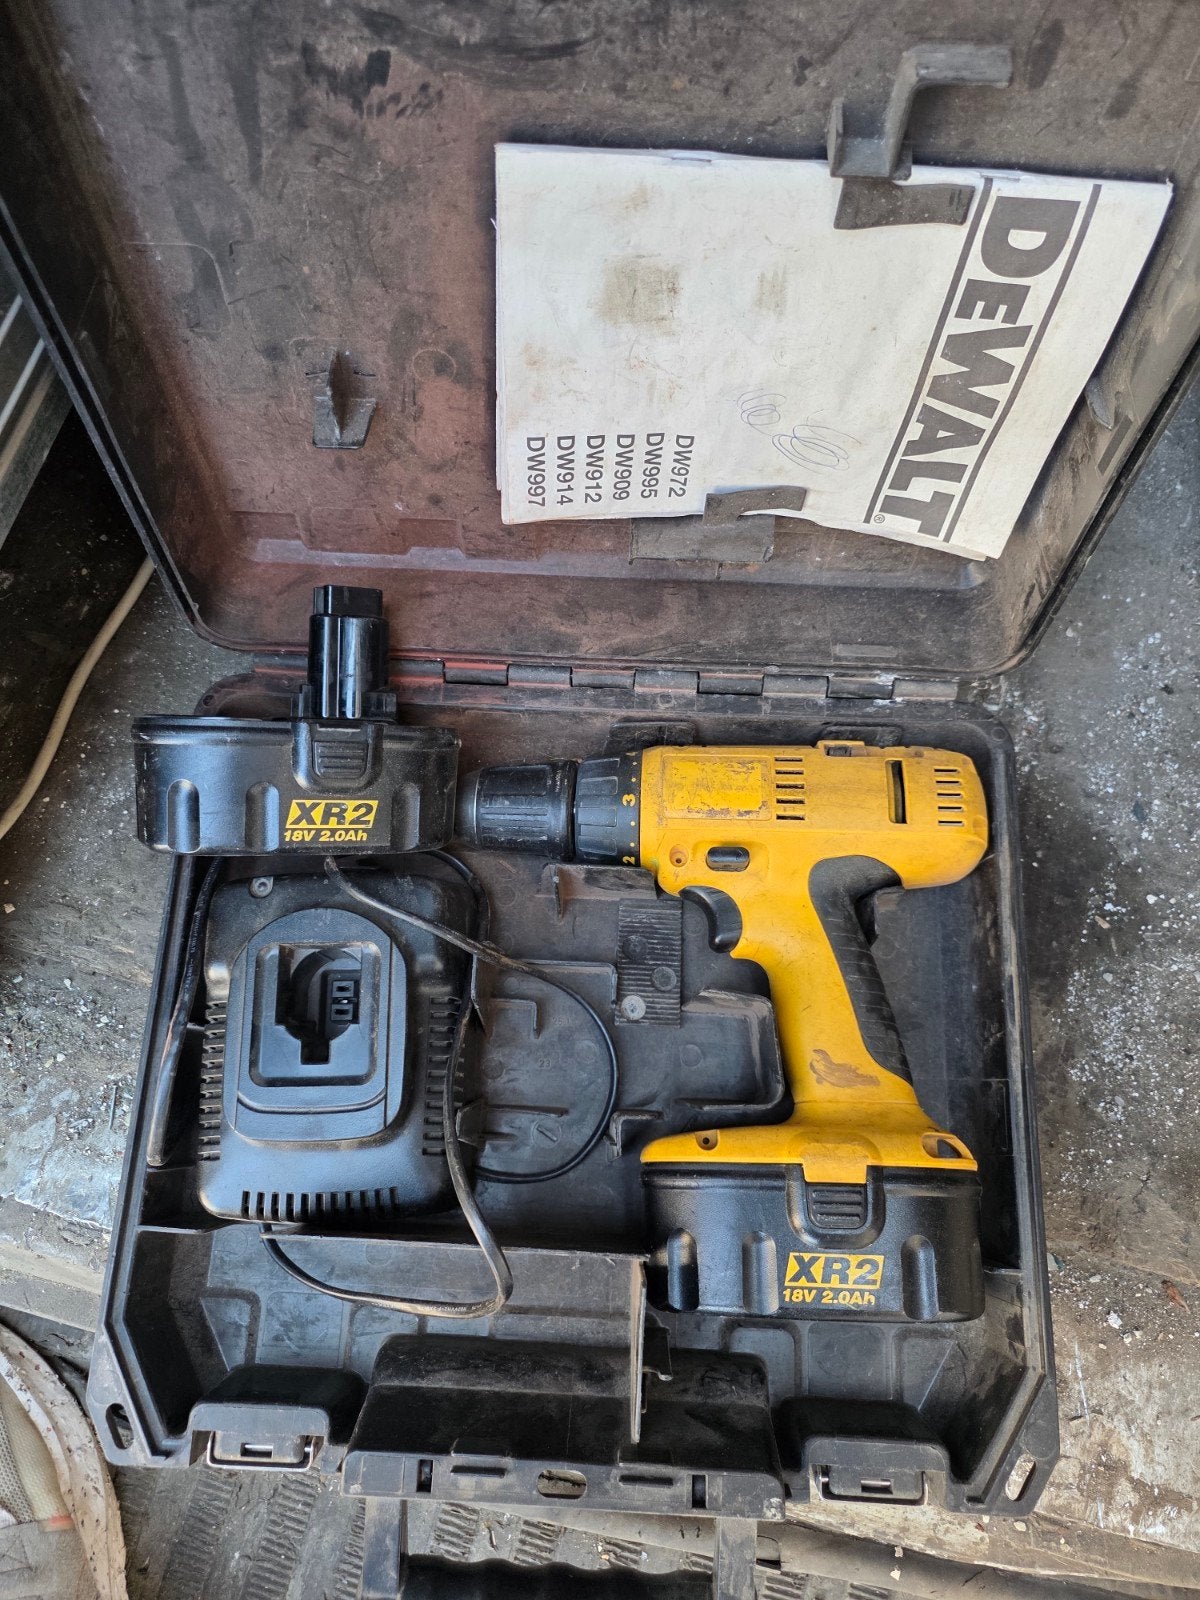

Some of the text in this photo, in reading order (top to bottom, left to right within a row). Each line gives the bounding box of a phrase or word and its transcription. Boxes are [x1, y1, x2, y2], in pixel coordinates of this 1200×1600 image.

[878, 195, 1082, 538] DEWALT
[526, 436, 546, 507] DW997
[556, 435, 576, 506] DW914
[584, 434, 606, 504] DW912
[612, 434, 636, 501] DW909
[640, 432, 665, 499] DW995
[668, 434, 695, 498] DW972
[288, 801, 374, 826] XR2
[622, 793, 636, 807] 3
[283, 829, 368, 842] 18V 2.0Ah
[783, 1288, 876, 1306] 18V 2.0Ah
[787, 1254, 880, 1286] XR2
